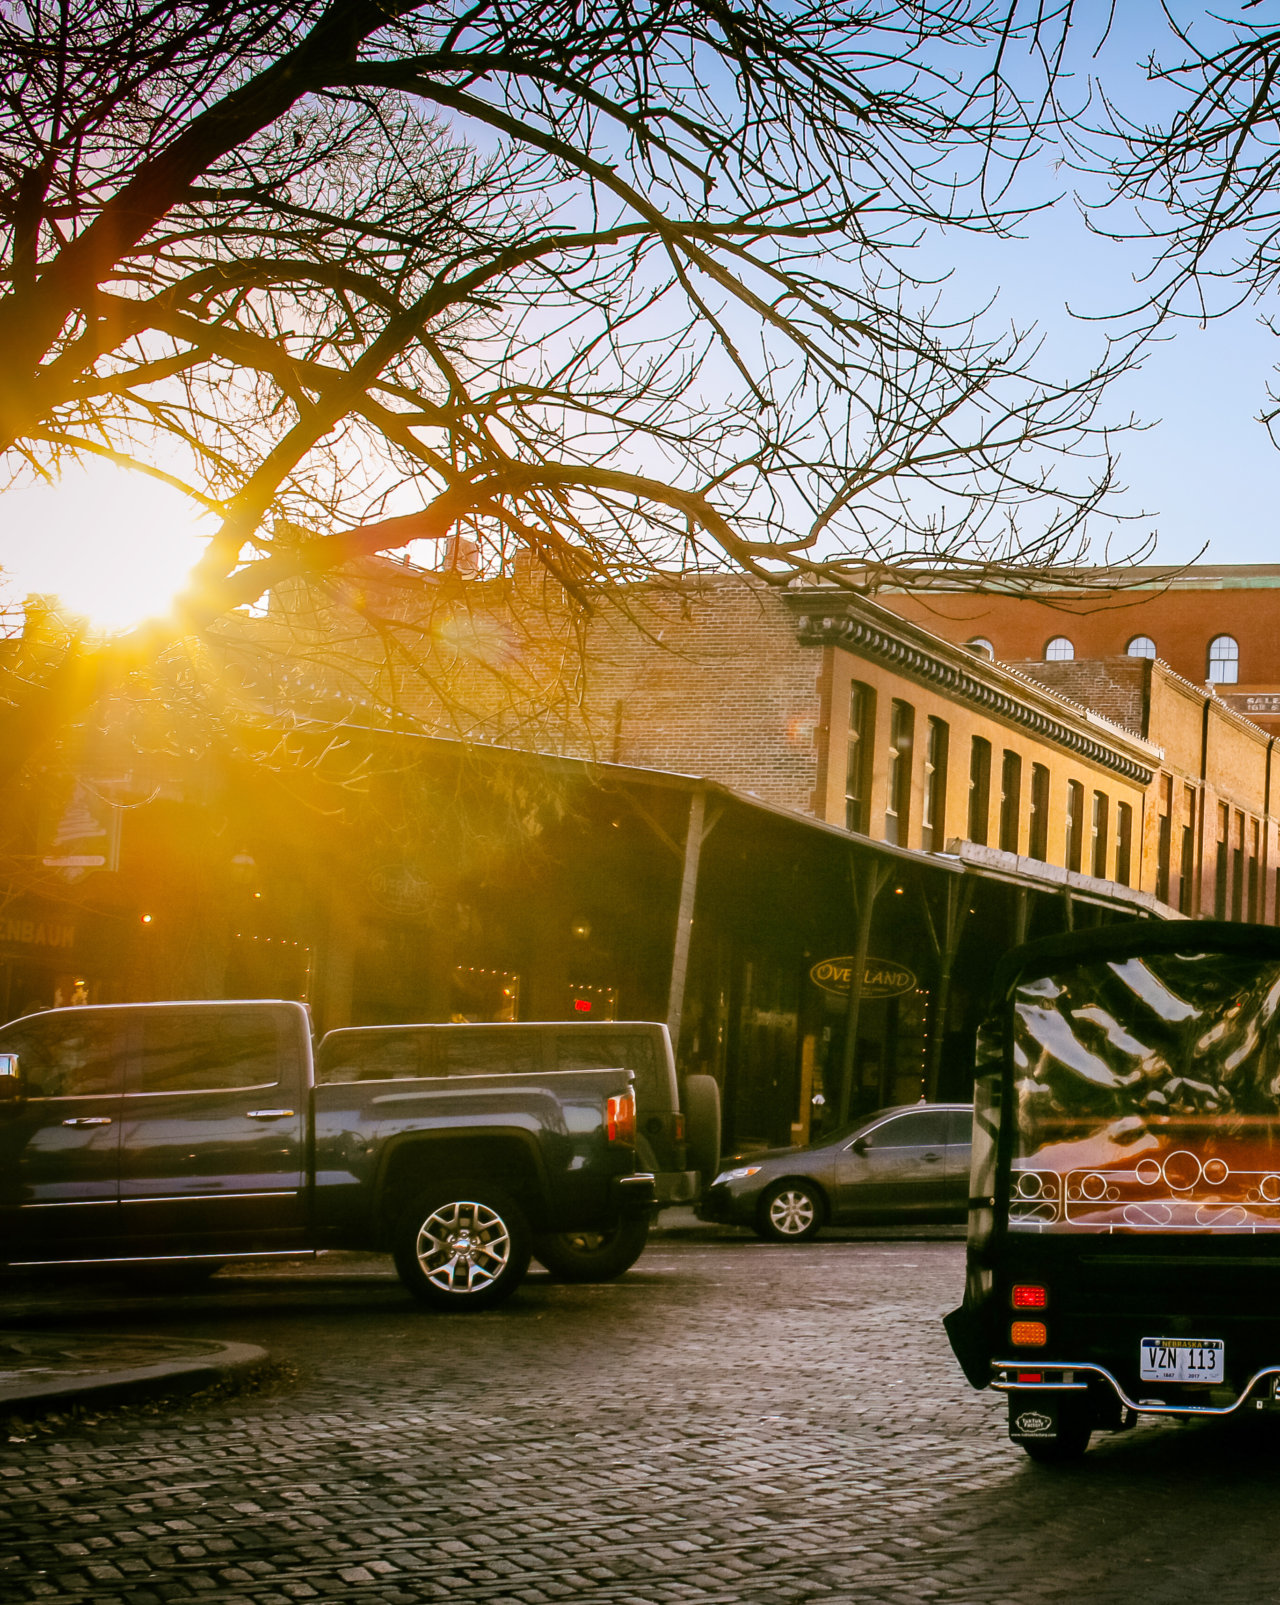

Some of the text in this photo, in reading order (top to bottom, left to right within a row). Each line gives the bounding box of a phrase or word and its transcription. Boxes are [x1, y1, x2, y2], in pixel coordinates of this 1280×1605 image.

[816, 963, 910, 986] OVELAND
[1162, 1340, 1202, 1348] NEBRASKA
[1149, 1347, 1216, 1370] VZN 113
